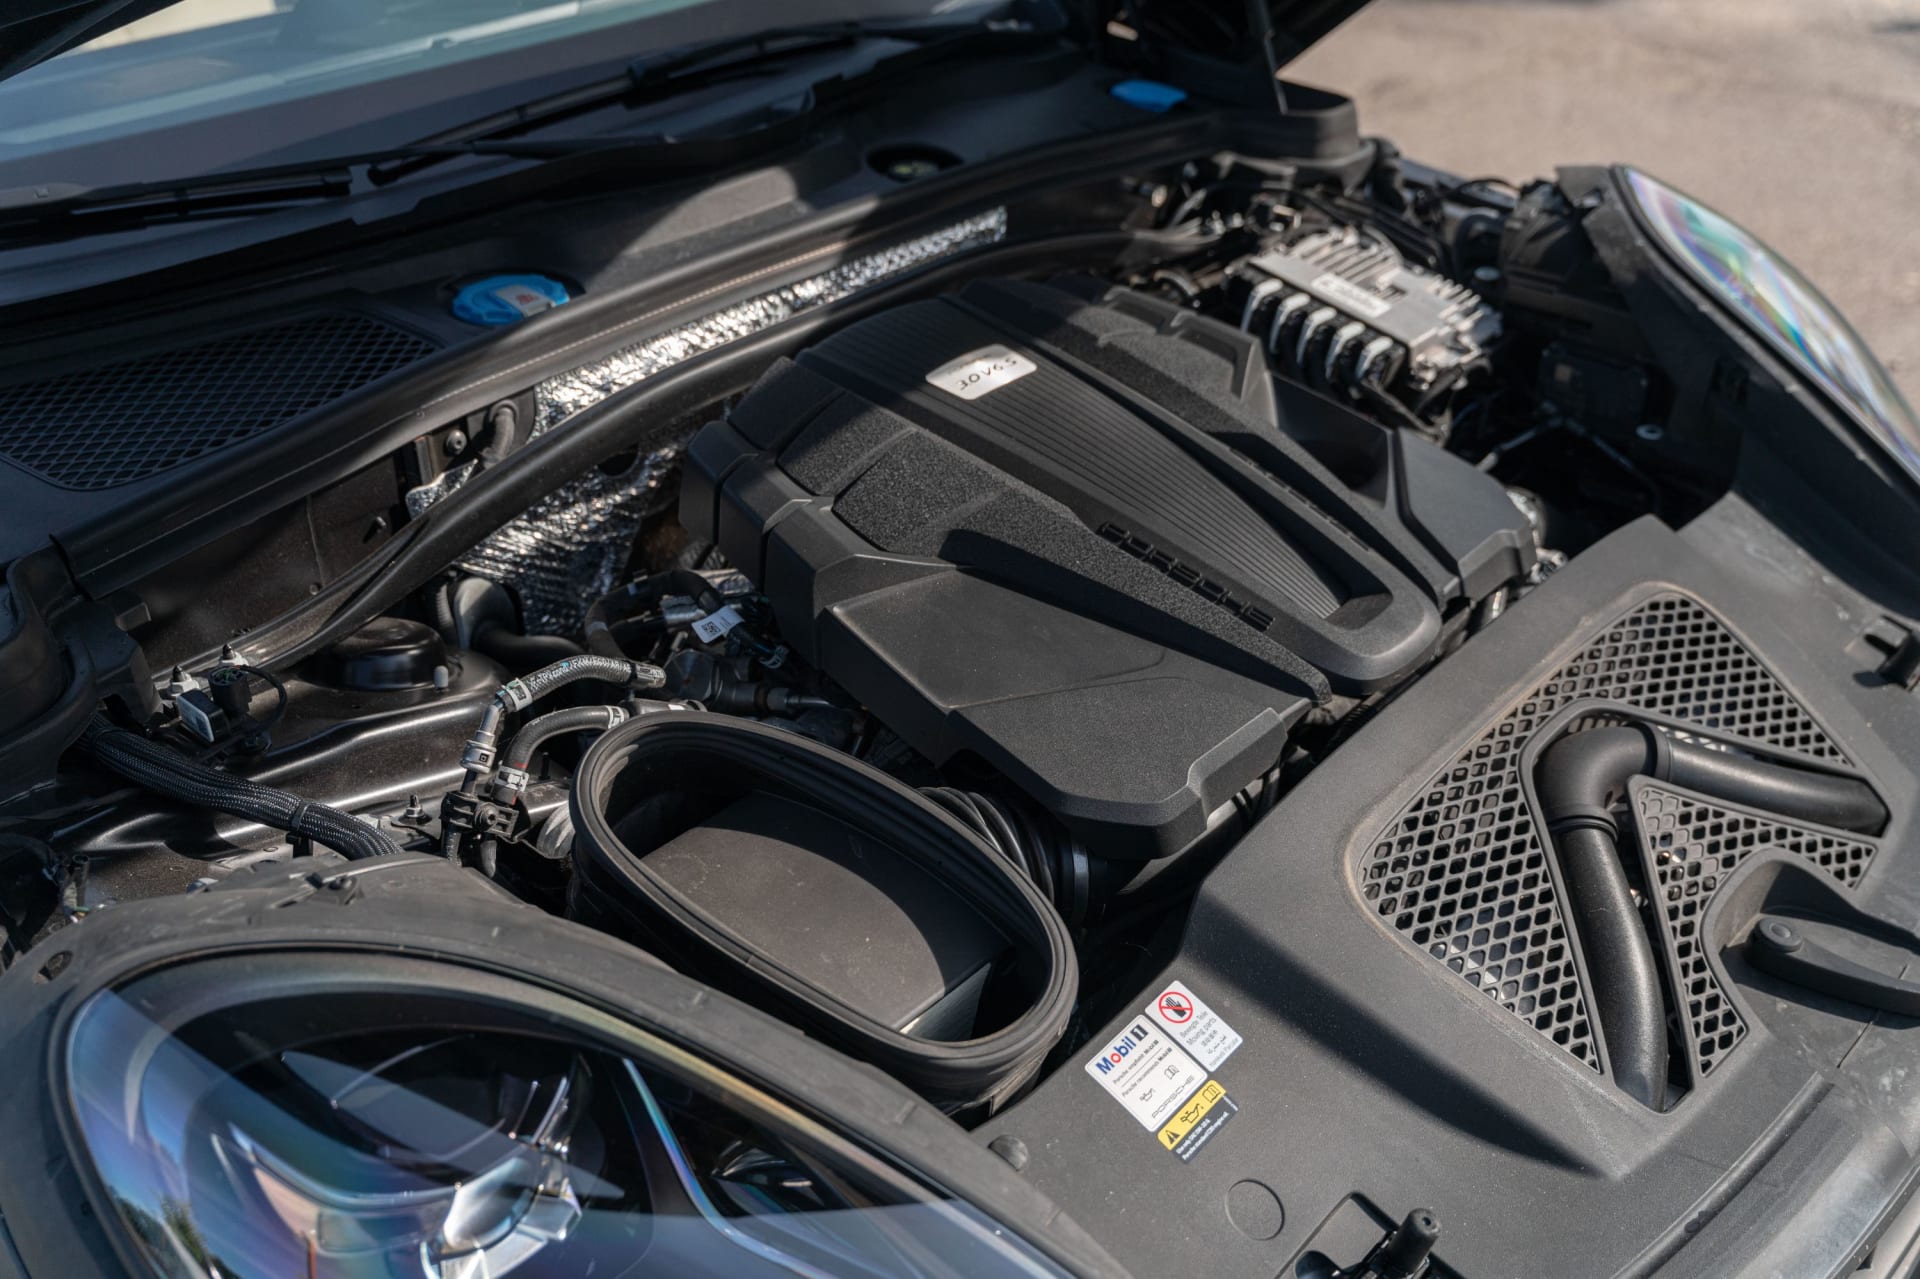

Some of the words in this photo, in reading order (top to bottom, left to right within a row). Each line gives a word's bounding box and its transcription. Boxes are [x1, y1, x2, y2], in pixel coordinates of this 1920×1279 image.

[1186, 1029, 1206, 1045] Moving
[1203, 1018, 1217, 1031] parts
[1095, 1036, 1137, 1075] Mobil
[1151, 1075, 1194, 1118] PORSCHE
